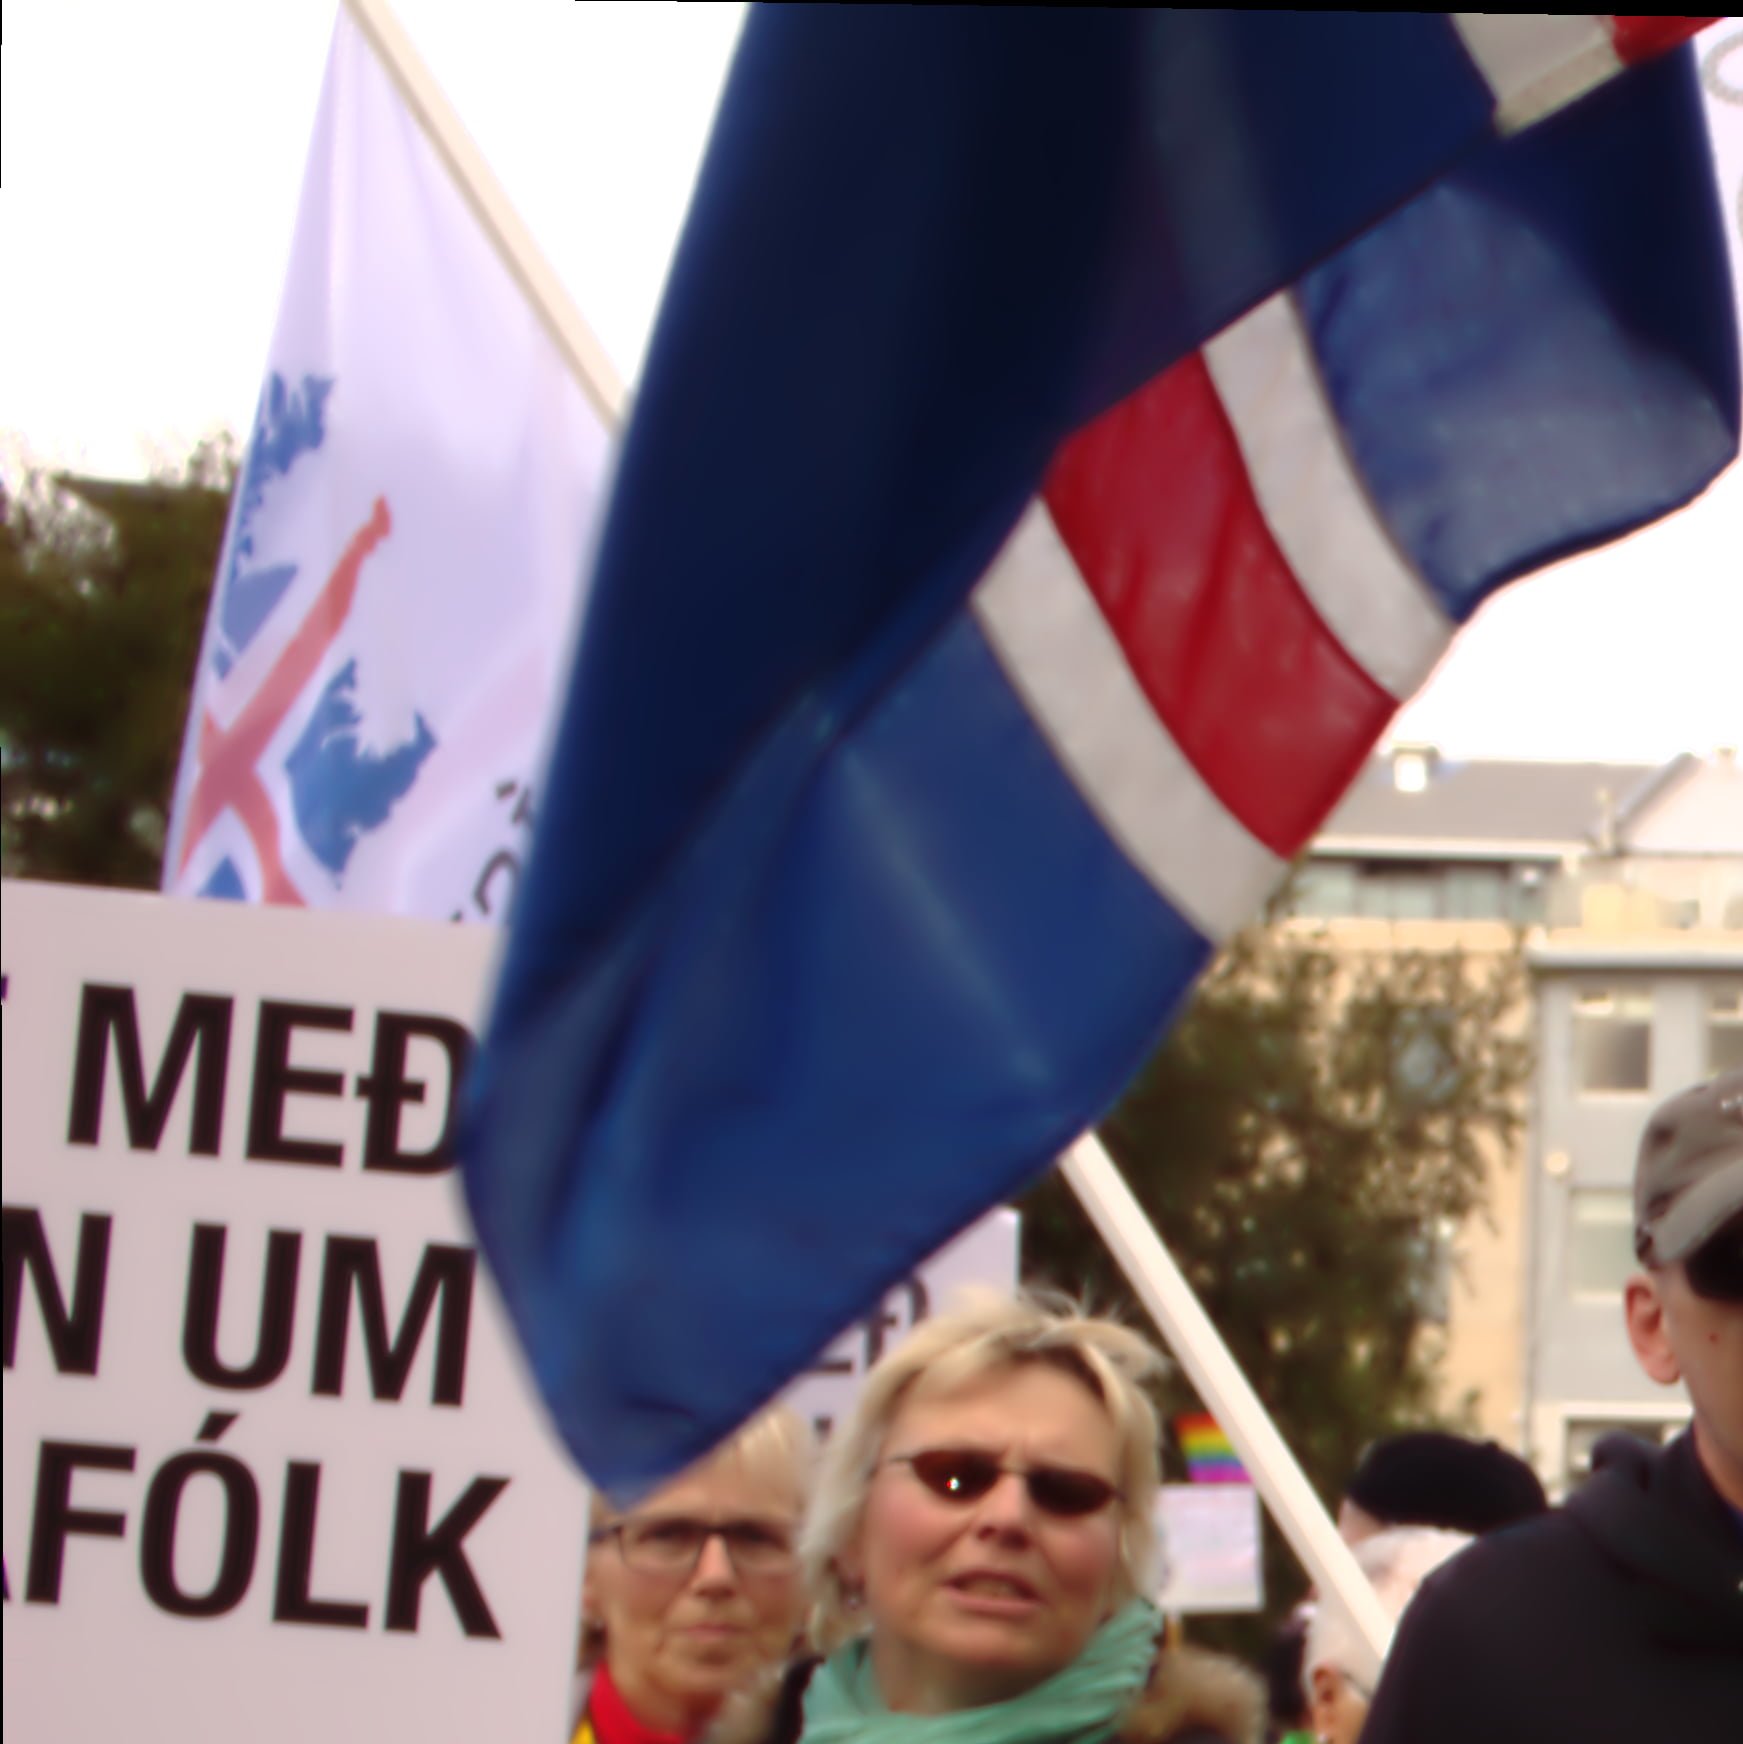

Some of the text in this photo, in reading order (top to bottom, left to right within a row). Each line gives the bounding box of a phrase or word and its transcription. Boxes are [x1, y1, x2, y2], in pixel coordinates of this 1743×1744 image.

[66, 982, 480, 1176] MEÐ
[181, 1221, 479, 1408] UM
[2, 1411, 512, 1641] FÓLK
